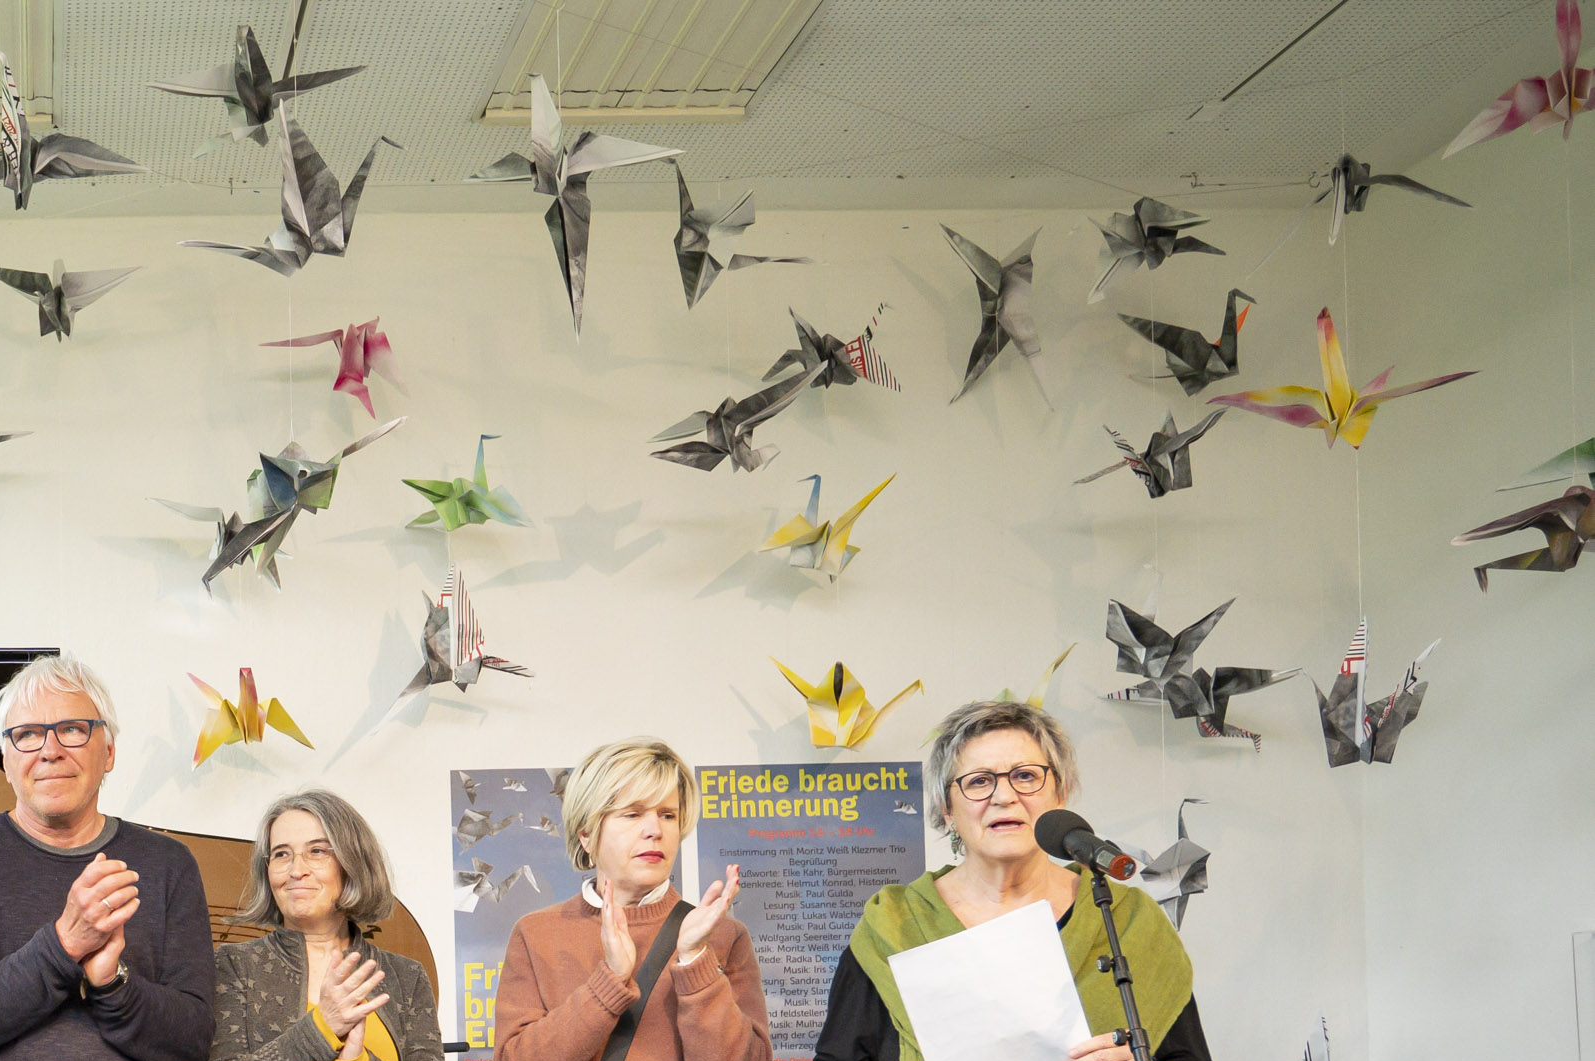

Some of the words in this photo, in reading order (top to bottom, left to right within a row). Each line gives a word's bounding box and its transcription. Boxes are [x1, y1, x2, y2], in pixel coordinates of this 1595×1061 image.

[701, 770, 789, 793] Friede
[799, 767, 908, 792] braucht
[702, 795, 859, 821] Erinnerung
[748, 828, 806, 840] Programm
[810, 827, 824, 837] 14
[838, 827, 853, 837] 18
[856, 826, 875, 836] Uhr
[719, 849, 777, 858] Einstimmung
[780, 847, 794, 856] mit
[797, 847, 824, 855] Moritz
[826, 846, 849, 855] Weiß
[852, 846, 886, 854] Klezmer
[889, 845, 906, 853] Trio
[789, 858, 837, 867] Begrüßung
[739, 868, 779, 877] rußworte:
[783, 868, 800, 877] Elke
[803, 868, 824, 877] Kahr,
[828, 867, 897, 876] Bürgermeisterin
[787, 879, 819, 888] Helmut
[822, 878, 856, 888] Konrad,
[859, 878, 900, 886] Historiker
[806, 890, 824, 898] Paul
[764, 902, 798, 911] Lesung:
[800, 901, 837, 909] Susanne
[766, 913, 800, 922] Lesung:
[828, 911, 863, 919] Walche
[808, 922, 826, 930] Paul
[759, 934, 800, 944] Wolfgang
[803, 932, 842, 941] Seereiter
[808, 944, 829, 952] Weiß
[780, 988, 807, 997] Poetry
